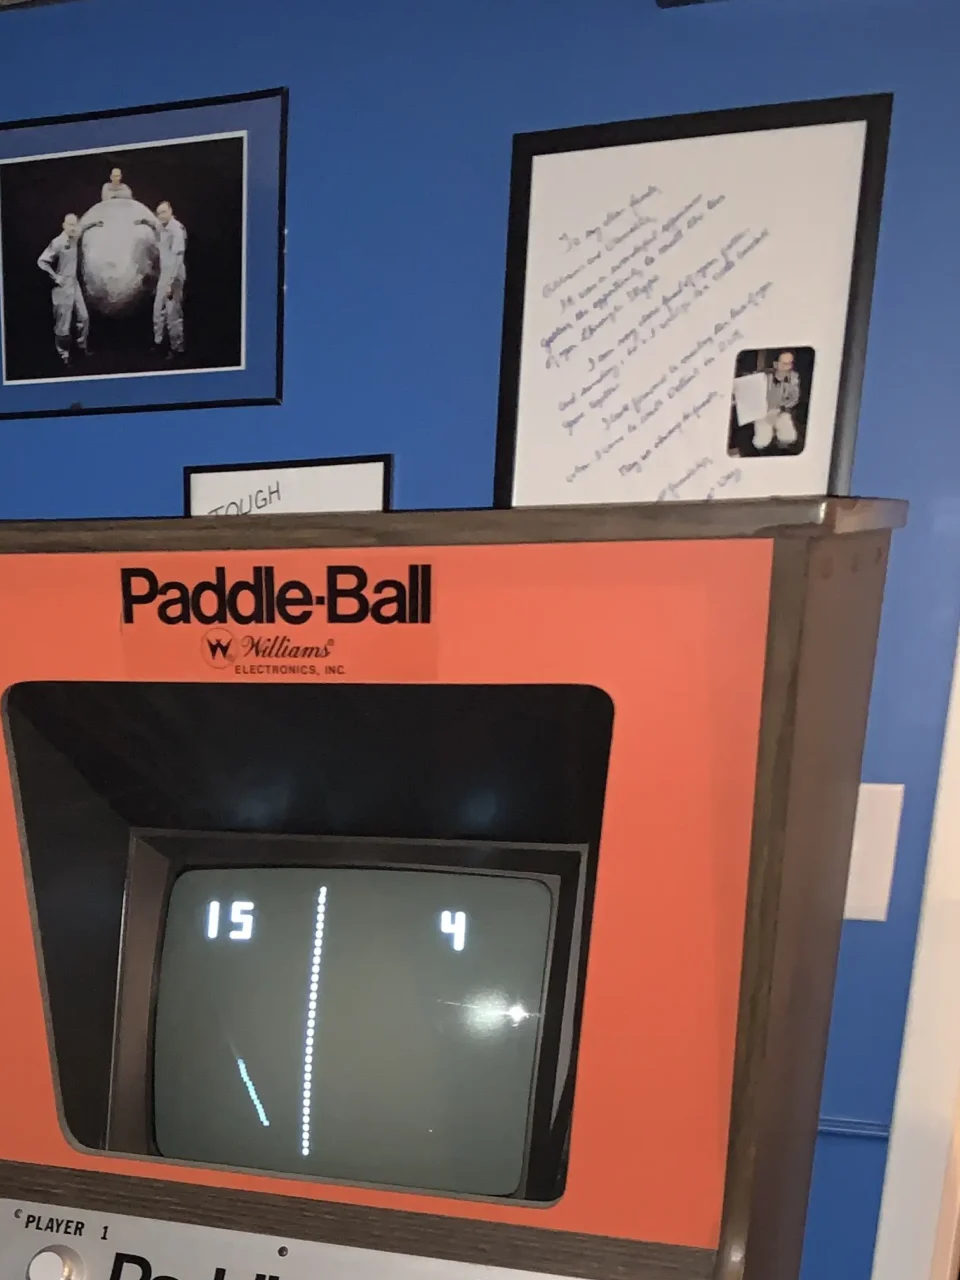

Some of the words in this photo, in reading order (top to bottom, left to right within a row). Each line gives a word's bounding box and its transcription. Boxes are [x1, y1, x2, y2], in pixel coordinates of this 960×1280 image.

[120, 564, 432, 624] Paddle-Ball
[235, 664, 320, 675] ELECTRONICS,
[207, 900, 254, 940] 15
[440, 910, 467, 951] 4
[25, 1214, 85, 1236] PLAYER
[100, 1225, 109, 1240] 1
